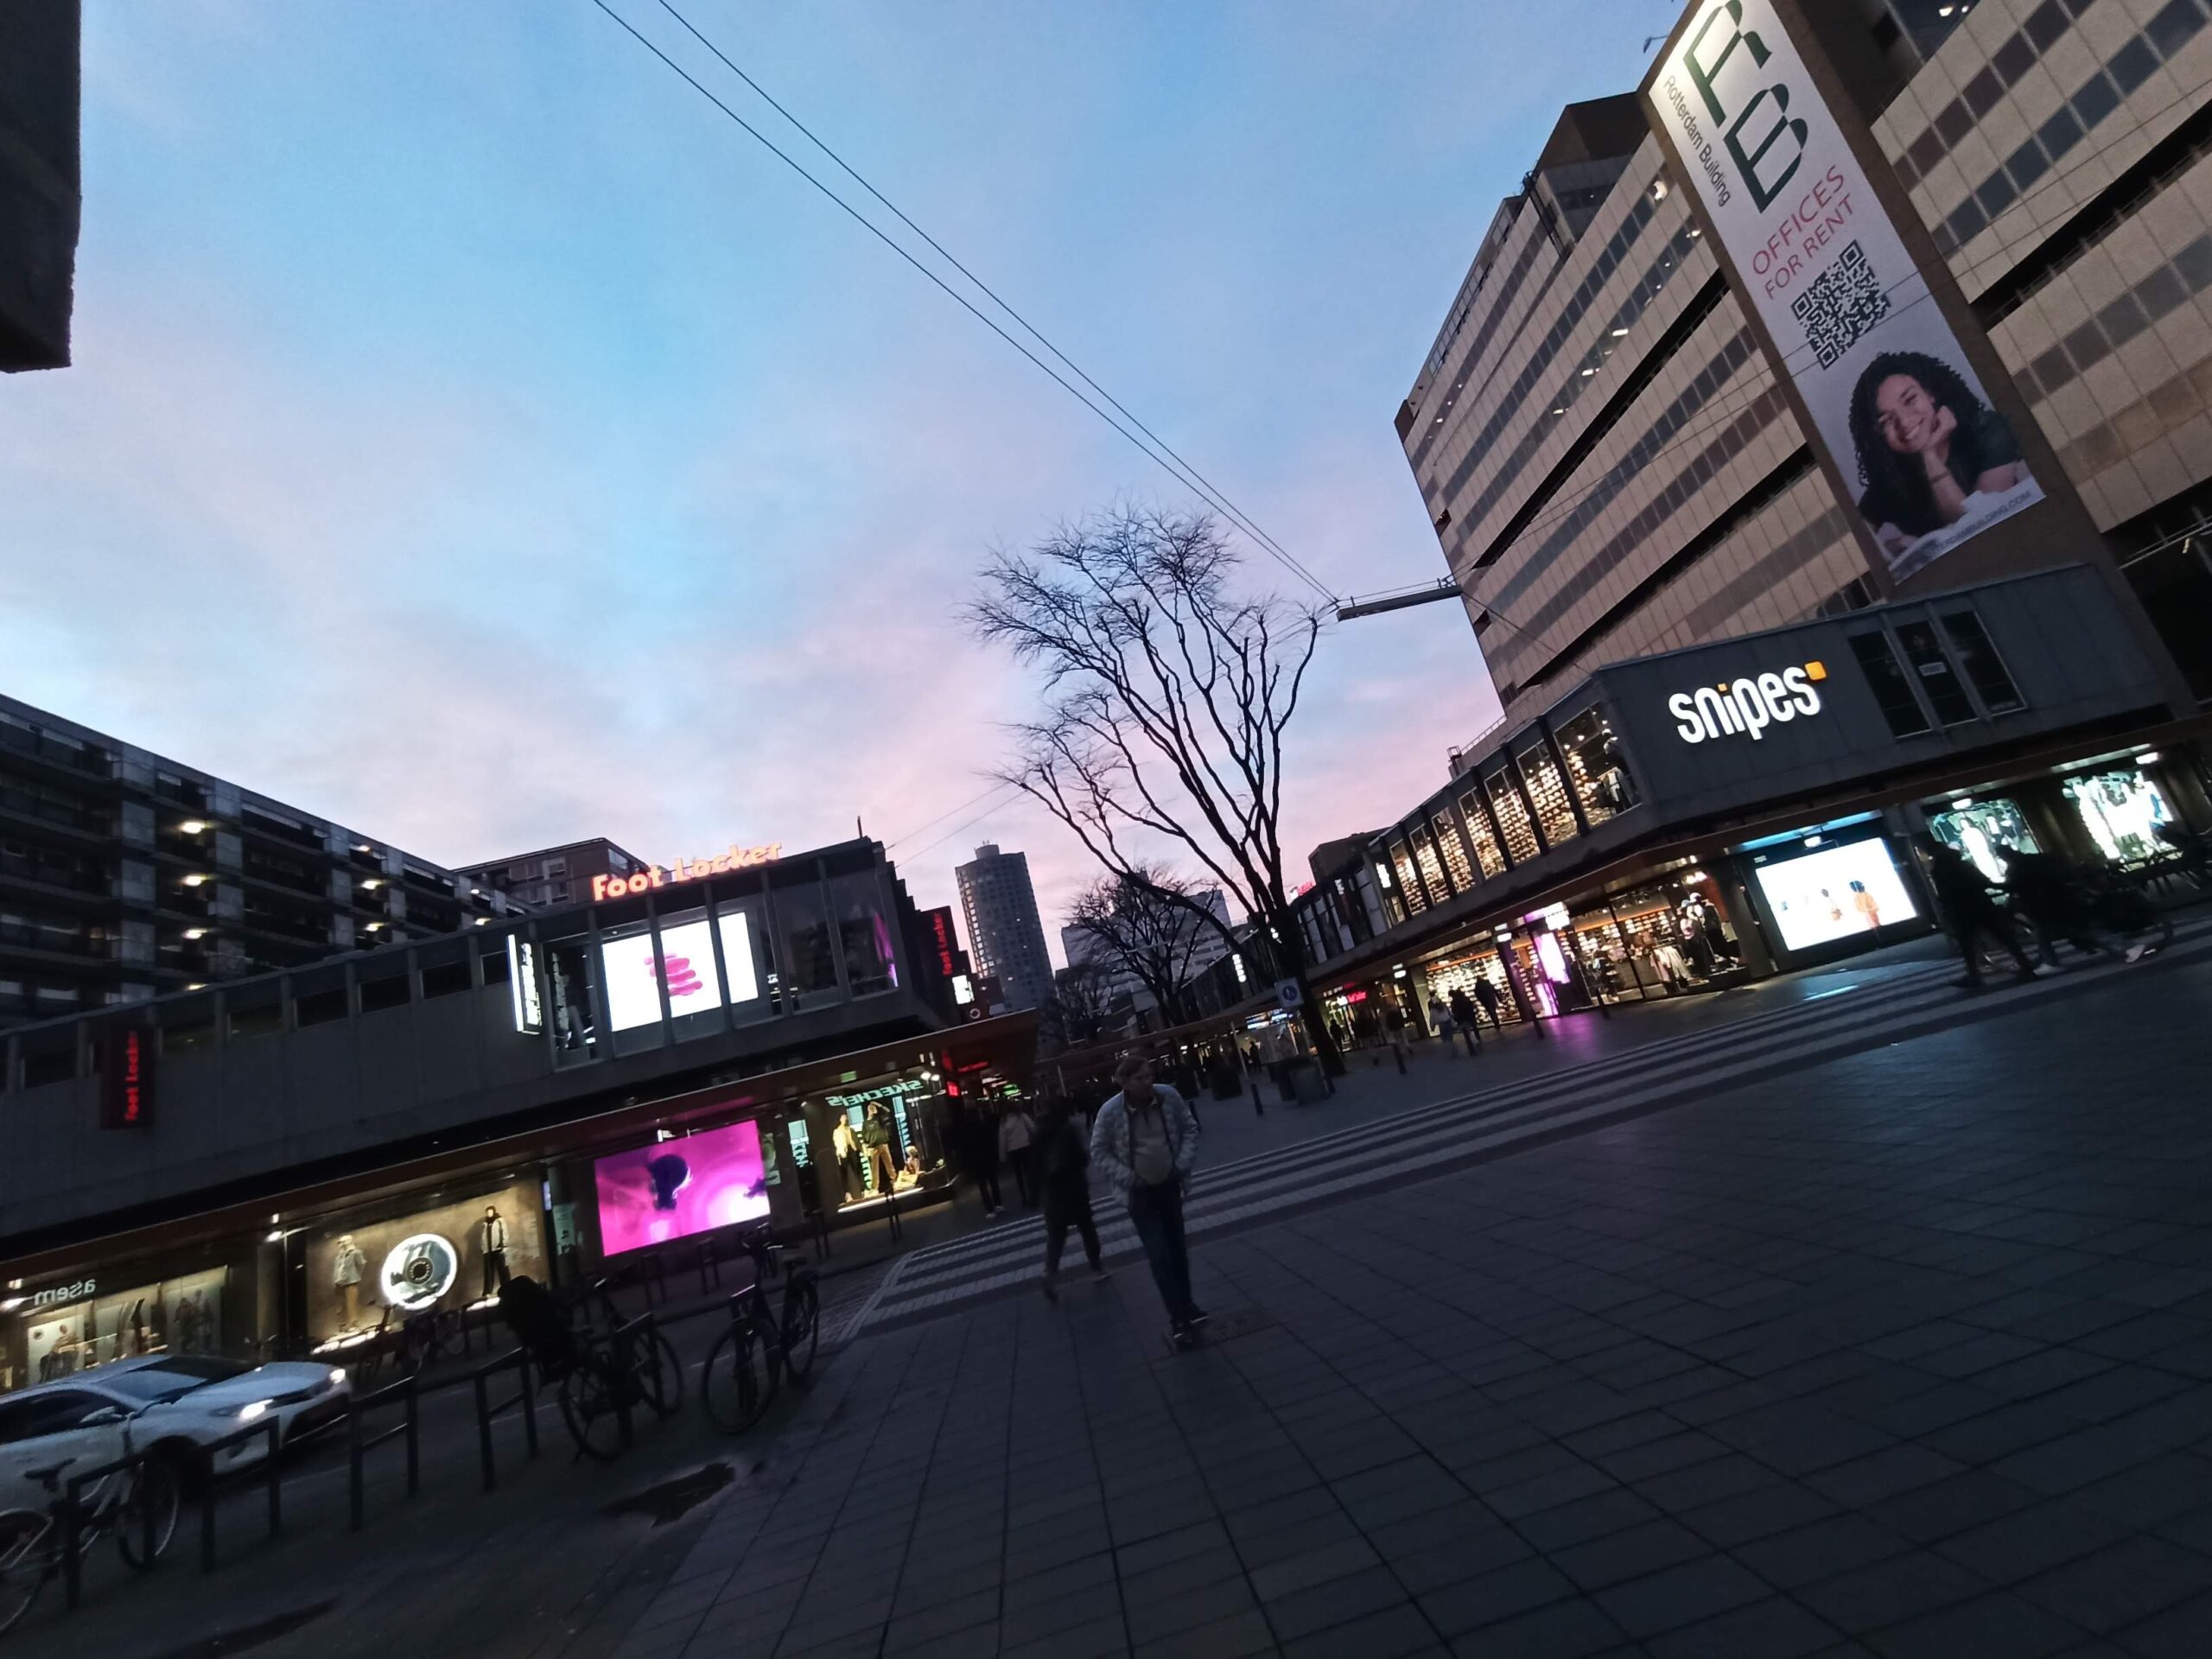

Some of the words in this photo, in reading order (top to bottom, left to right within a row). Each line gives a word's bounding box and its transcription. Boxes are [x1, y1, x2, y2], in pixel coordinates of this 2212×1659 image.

[1663, 75, 1705, 150] Rotterdam
[1700, 143, 1731, 207] Building
[1753, 164, 1844, 275] OFFICES
[1764, 254, 1803, 300] FOR
[1802, 193, 1853, 258] RENT
[1669, 665, 1821, 744] snipes
[592, 864, 664, 901] Foot
[672, 842, 782, 882] Locker
[933, 912, 948, 949] Locker
[939, 950, 953, 976] Foot
[124, 1087, 138, 1121] Foot
